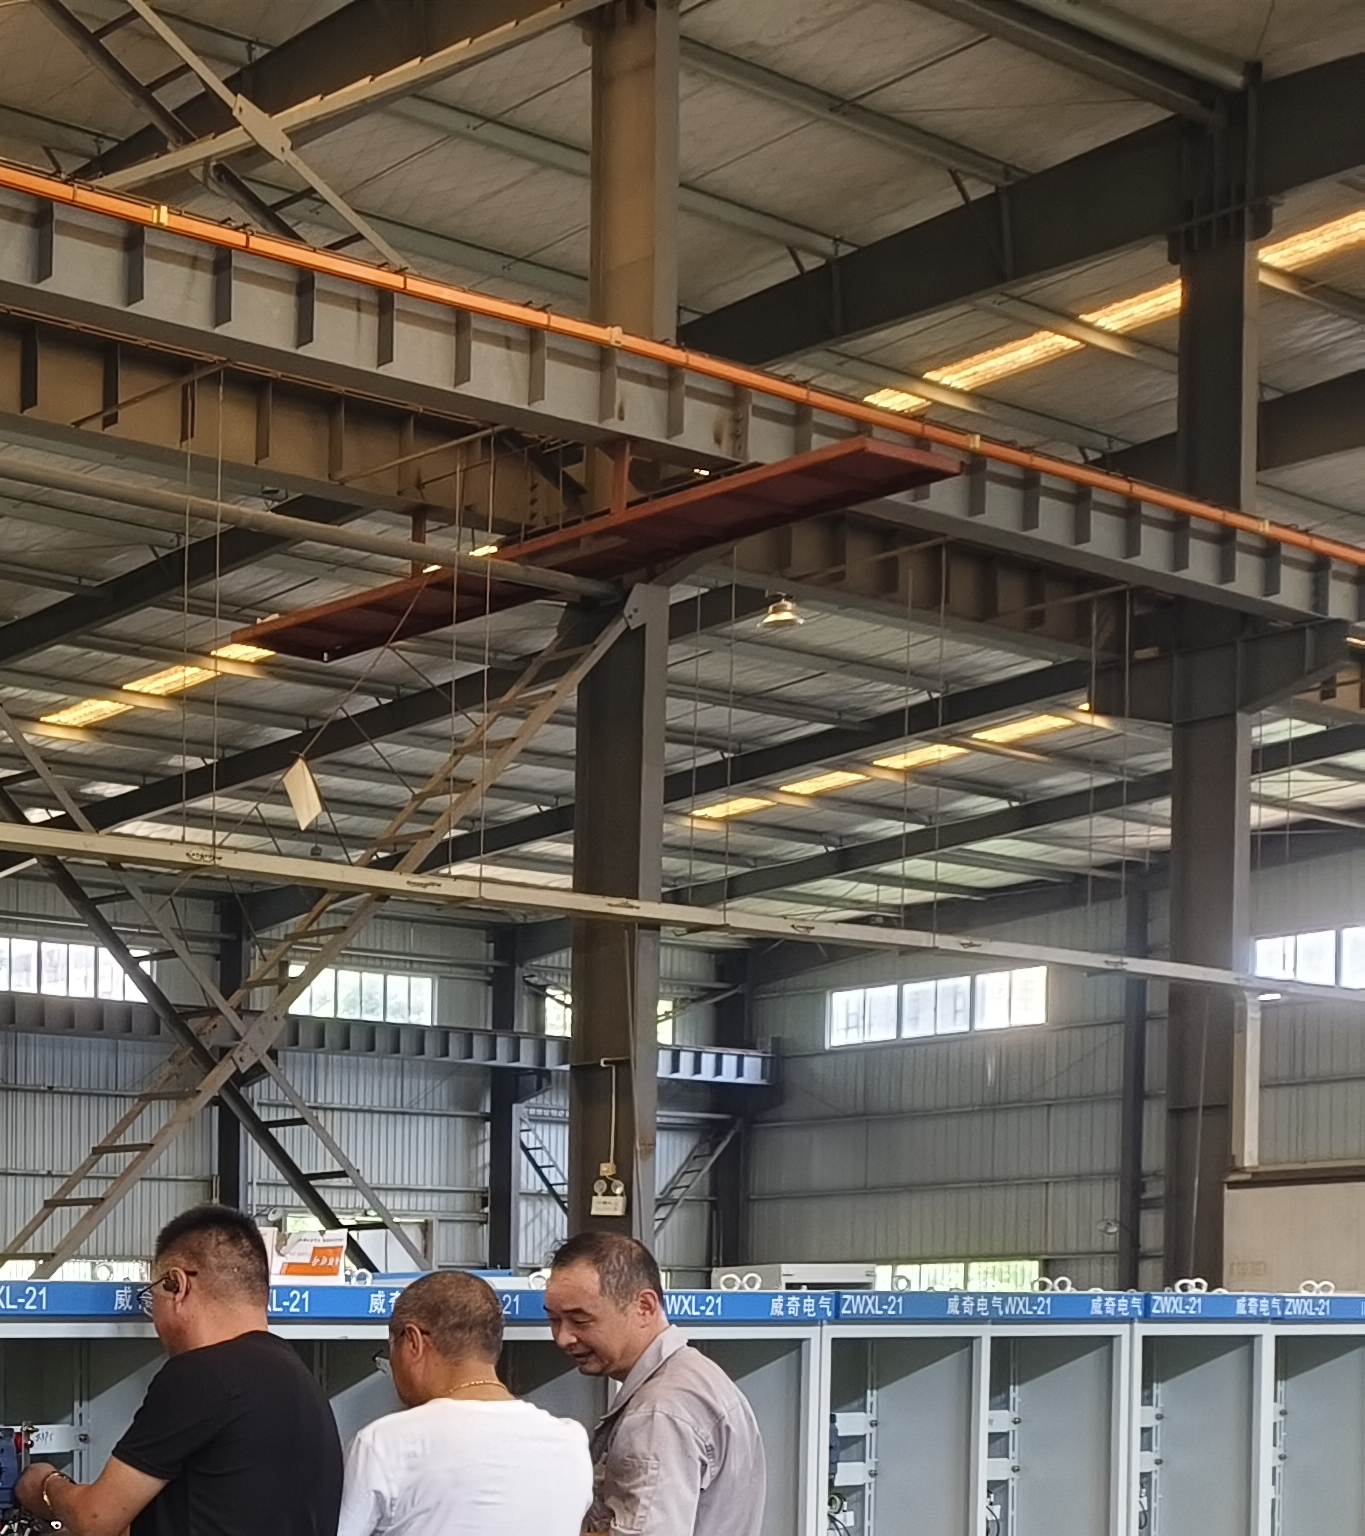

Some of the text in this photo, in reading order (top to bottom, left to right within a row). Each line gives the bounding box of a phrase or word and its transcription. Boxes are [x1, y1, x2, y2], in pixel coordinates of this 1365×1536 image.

[267, 1289, 310, 1313] L-21
[501, 1294, 520, 1315] 21
[663, 1295, 722, 1317] WXL-21
[770, 1296, 833, 1318] 威奇电气
[840, 1295, 903, 1316] ZWXL-21
[946, 1296, 1004, 1317] 威奇电气
[1151, 1297, 1202, 1315] ZWXL-21
[1285, 1298, 1331, 1316] ZWXL-21
